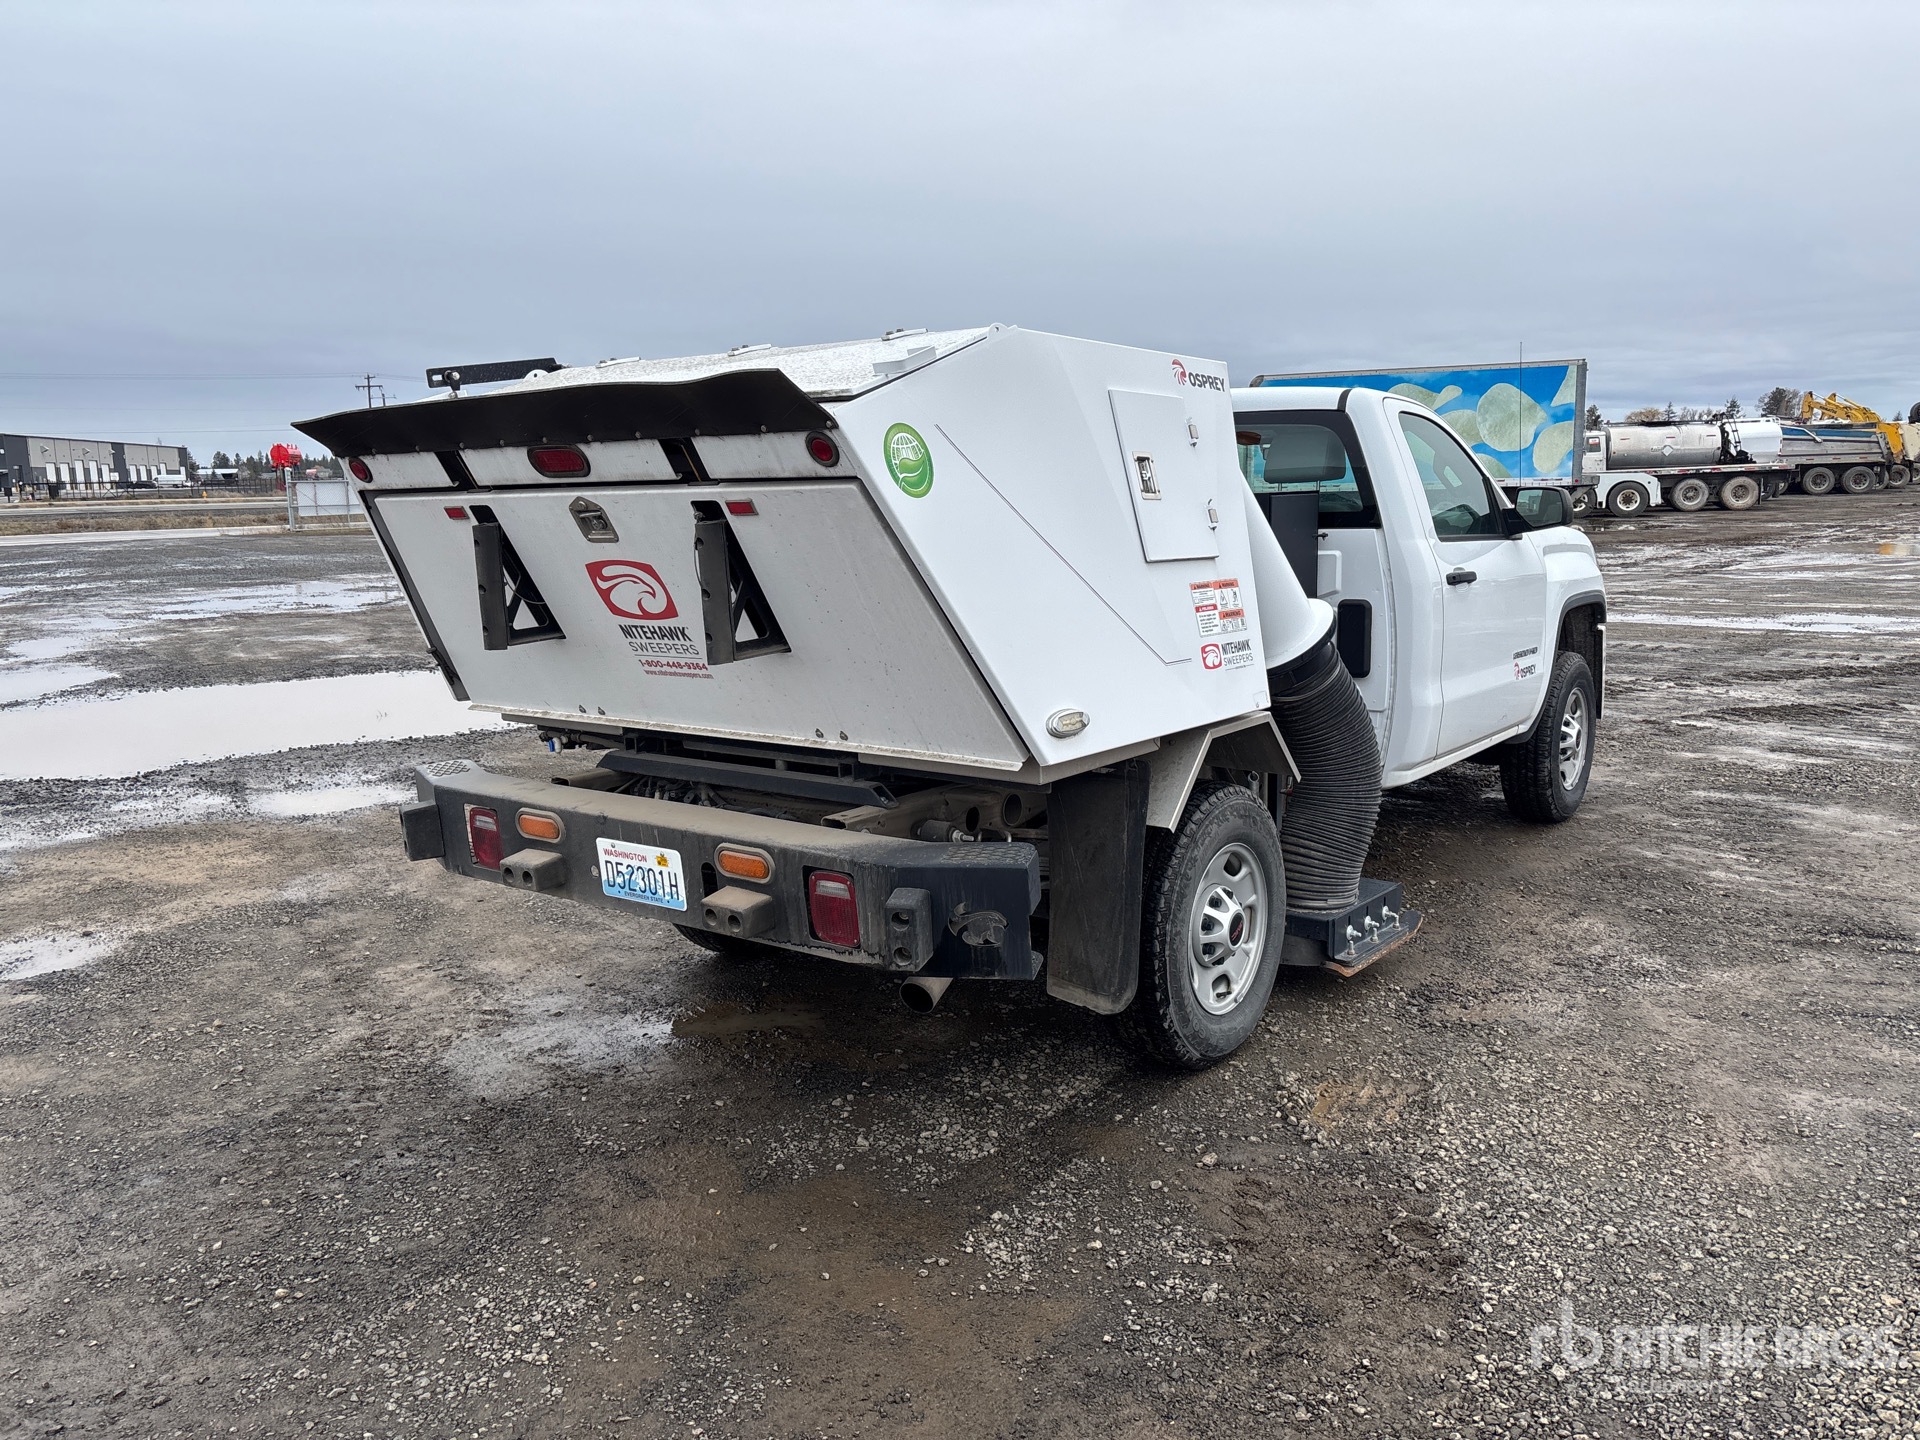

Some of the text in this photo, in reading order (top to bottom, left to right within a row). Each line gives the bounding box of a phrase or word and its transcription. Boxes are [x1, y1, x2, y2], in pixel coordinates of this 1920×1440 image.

[1188, 371, 1225, 392] OSPREY
[618, 624, 693, 642] NITEHAWK
[628, 641, 700, 655] SWEEPERS
[1221, 639, 1252, 656] NITEHAWK
[1223, 653, 1254, 666] SWEEPERS
[1520, 664, 1536, 678] OSPREY
[603, 848, 648, 862] WASHINGTON
[604, 859, 680, 901] D52301H
[624, 891, 650, 901] EVERGREEN
